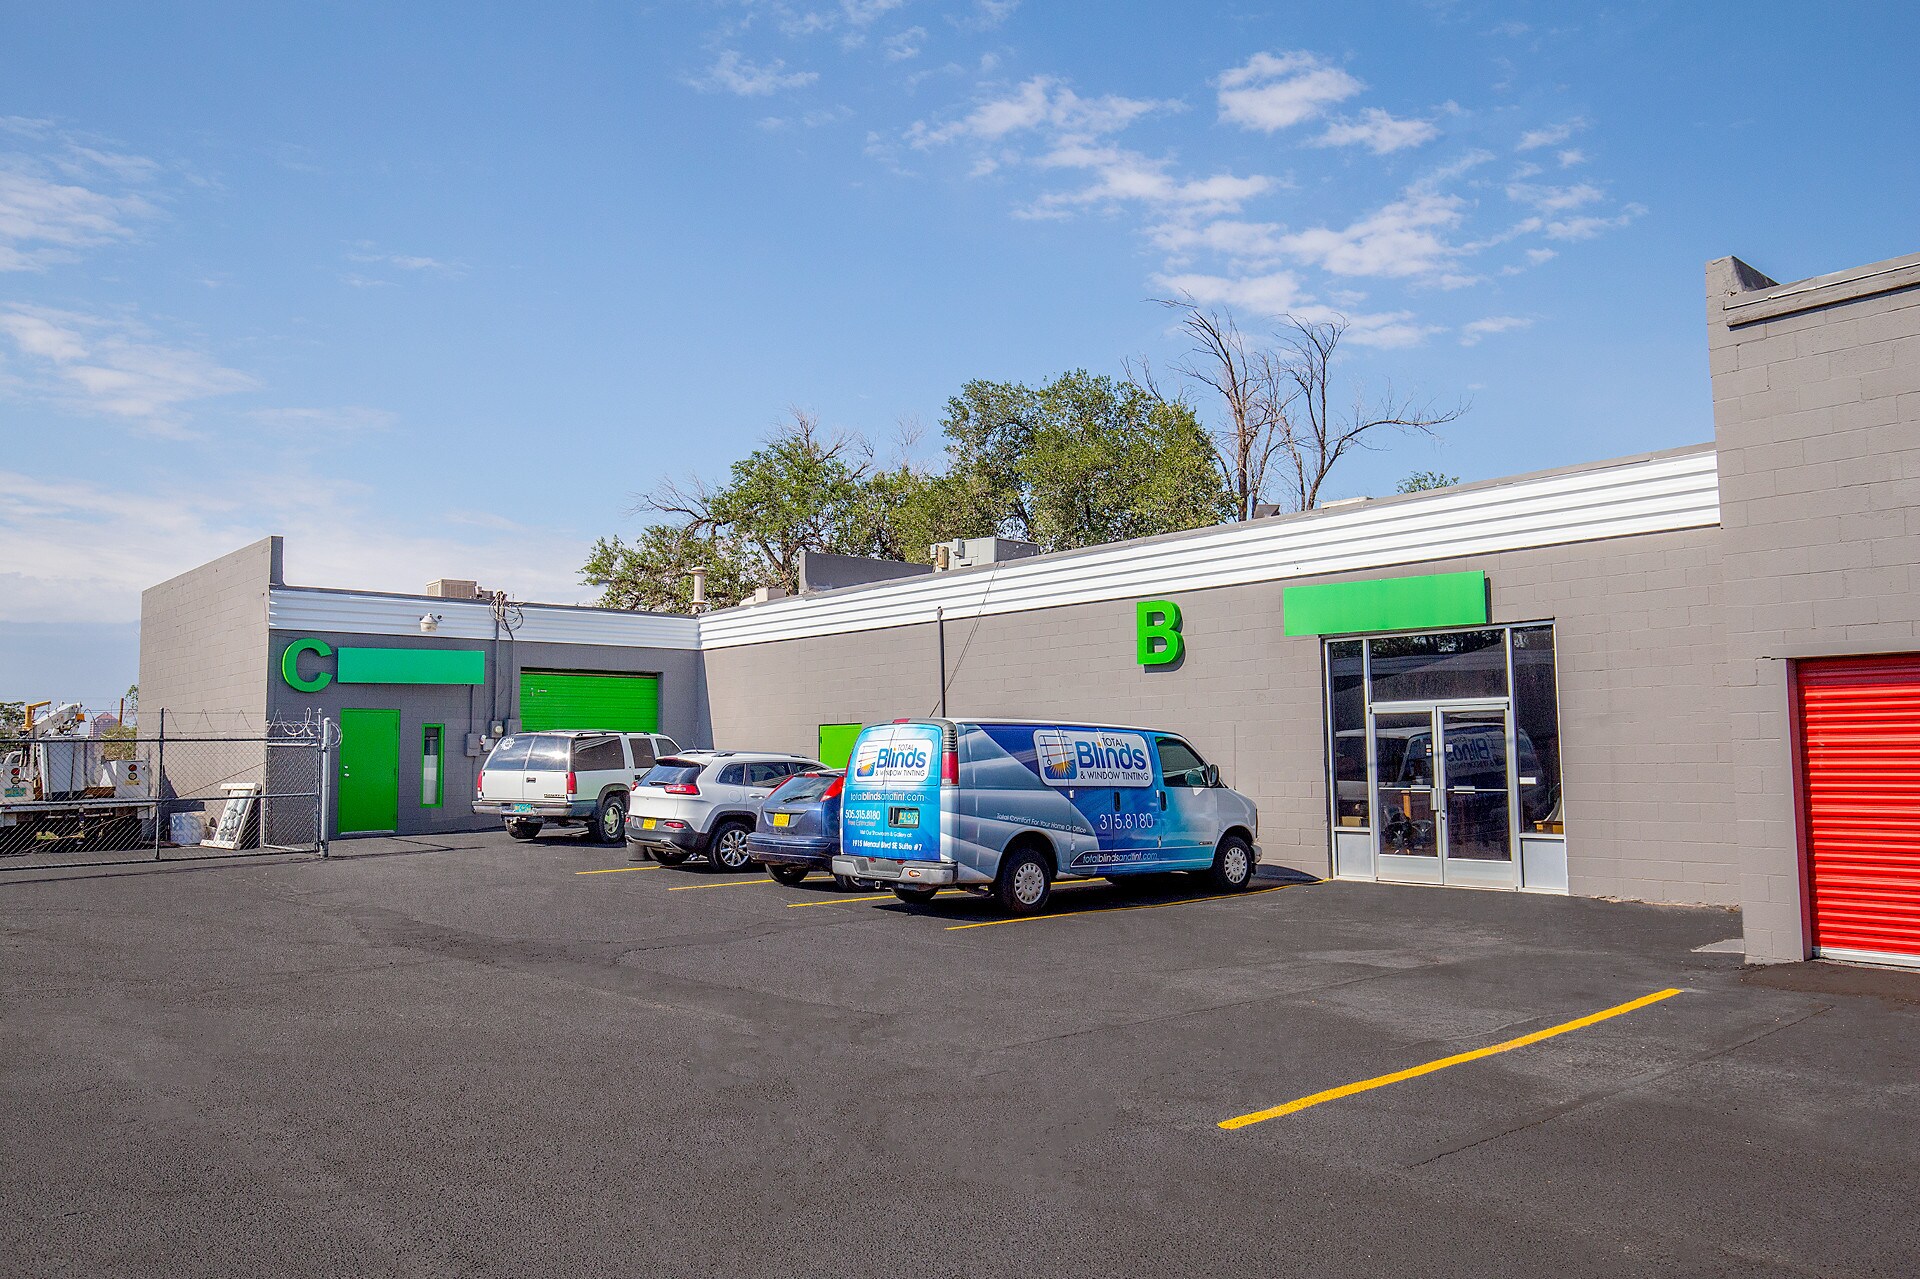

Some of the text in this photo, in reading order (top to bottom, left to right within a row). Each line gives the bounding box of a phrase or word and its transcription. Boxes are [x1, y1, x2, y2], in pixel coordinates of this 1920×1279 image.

[1137, 600, 1183, 665] B
[282, 637, 333, 693] C
[1102, 738, 1124, 747] TOTAL
[876, 748, 927, 769] Blinds
[1075, 741, 1147, 770] Blinds
[1080, 771, 1149, 781] & WINDOW TINTING
[845, 809, 880, 820] 505.315.8180
[1100, 812, 1154, 830] 315.8180
[1009, 815, 1031, 824] Comfort
[1051, 822, 1065, 830] Home
[1072, 825, 1087, 834] Office
[1083, 851, 1158, 864] totalblindsandtint.com
